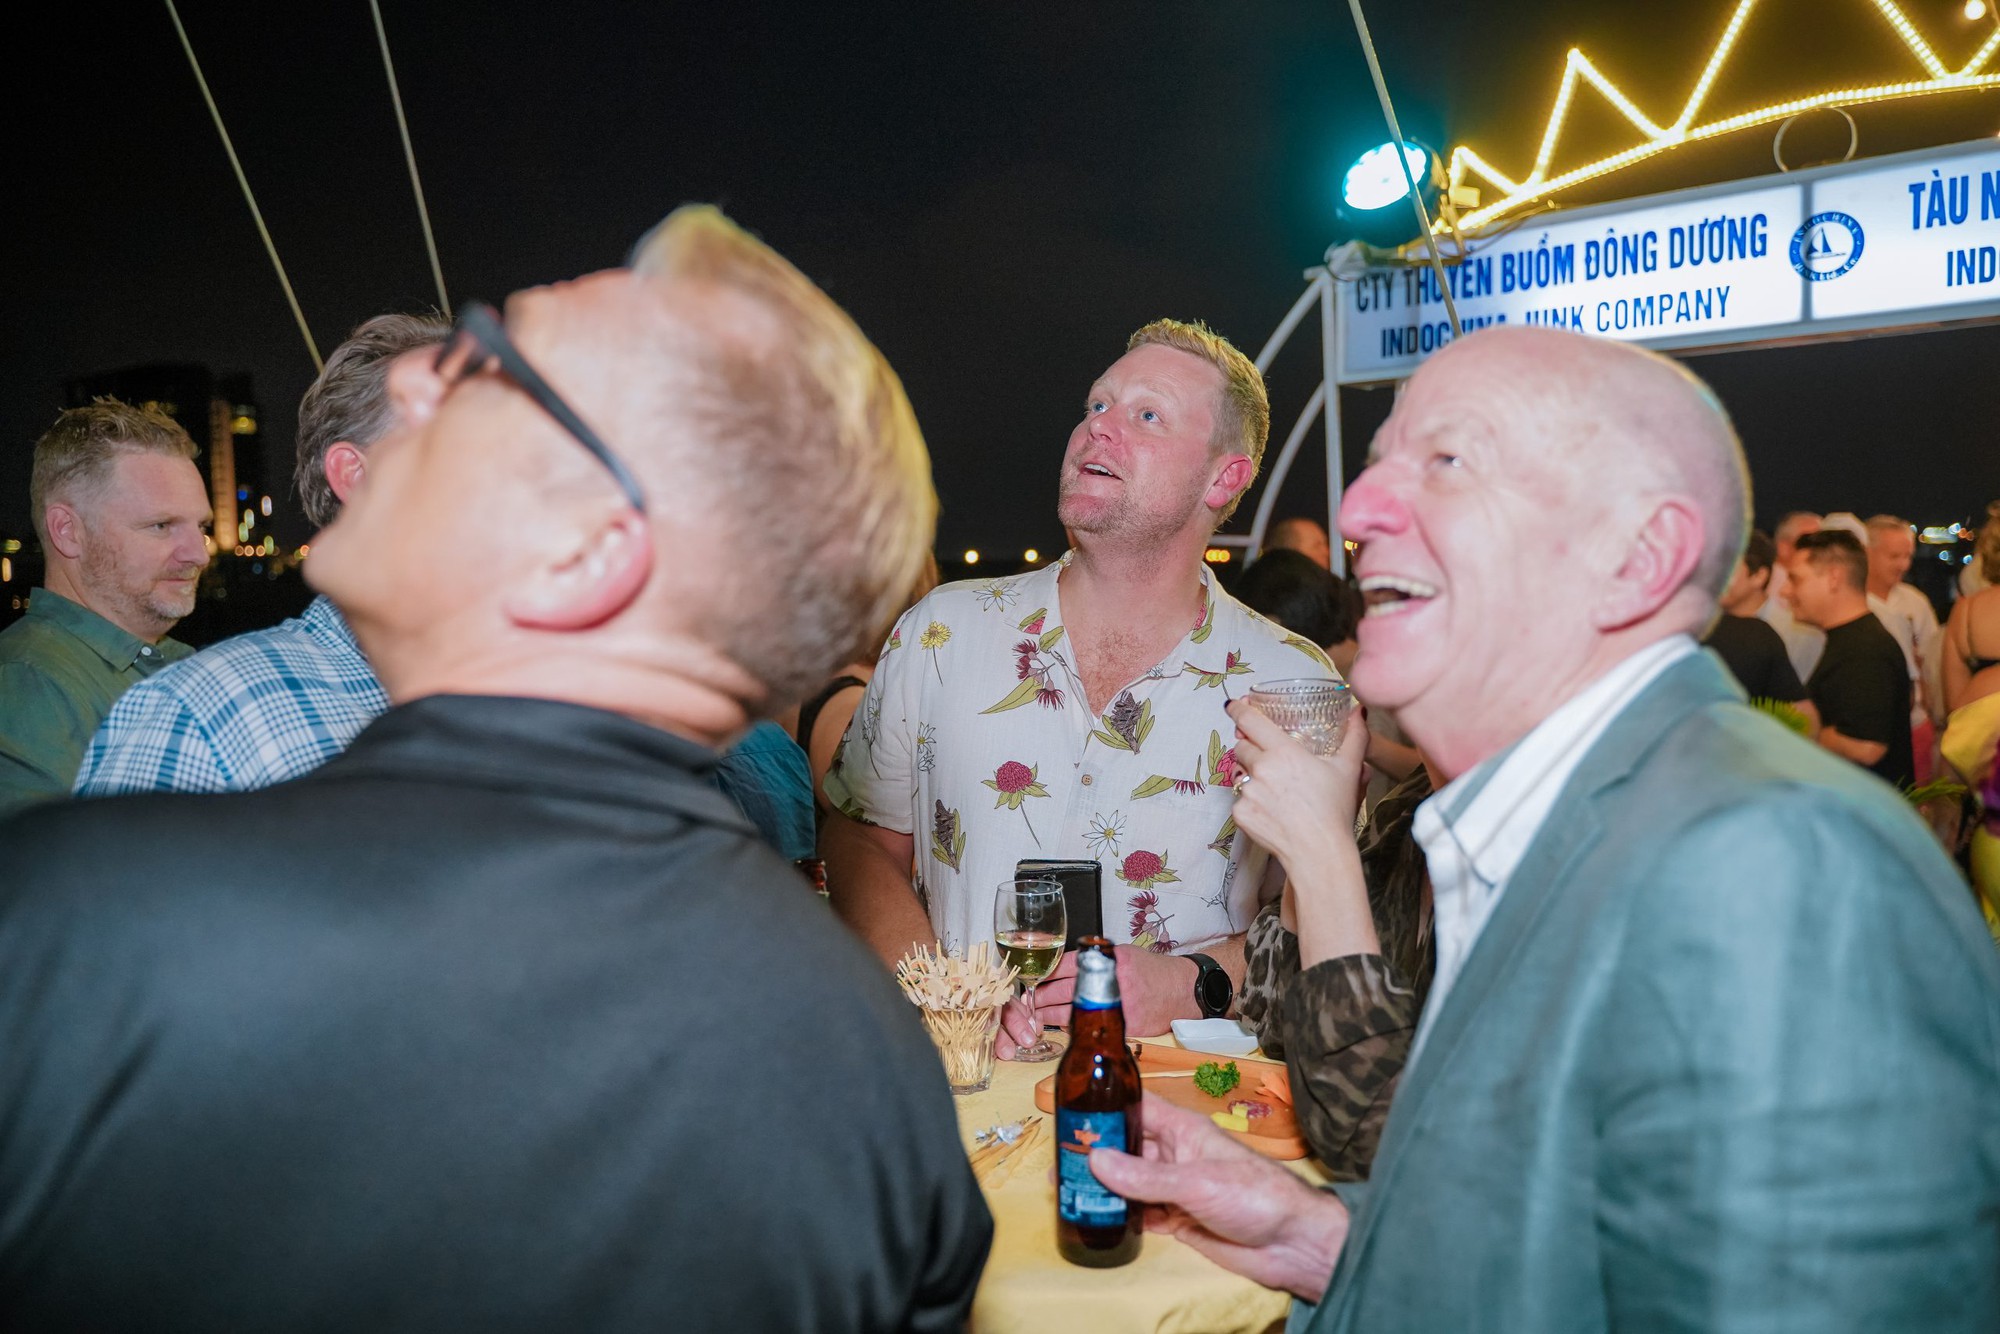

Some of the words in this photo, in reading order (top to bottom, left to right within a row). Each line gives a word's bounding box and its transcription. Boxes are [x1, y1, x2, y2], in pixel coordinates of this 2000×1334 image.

[1908, 169, 1970, 230] TÀU
[1356, 272, 1394, 312] CTY
[1585, 228, 1658, 281] ĐÔNG
[1668, 213, 1768, 269] DƯƠNG
[1946, 246, 2000, 287] IND
[1381, 314, 1507, 357] INDOC
[1597, 285, 1731, 332] COMPANY
